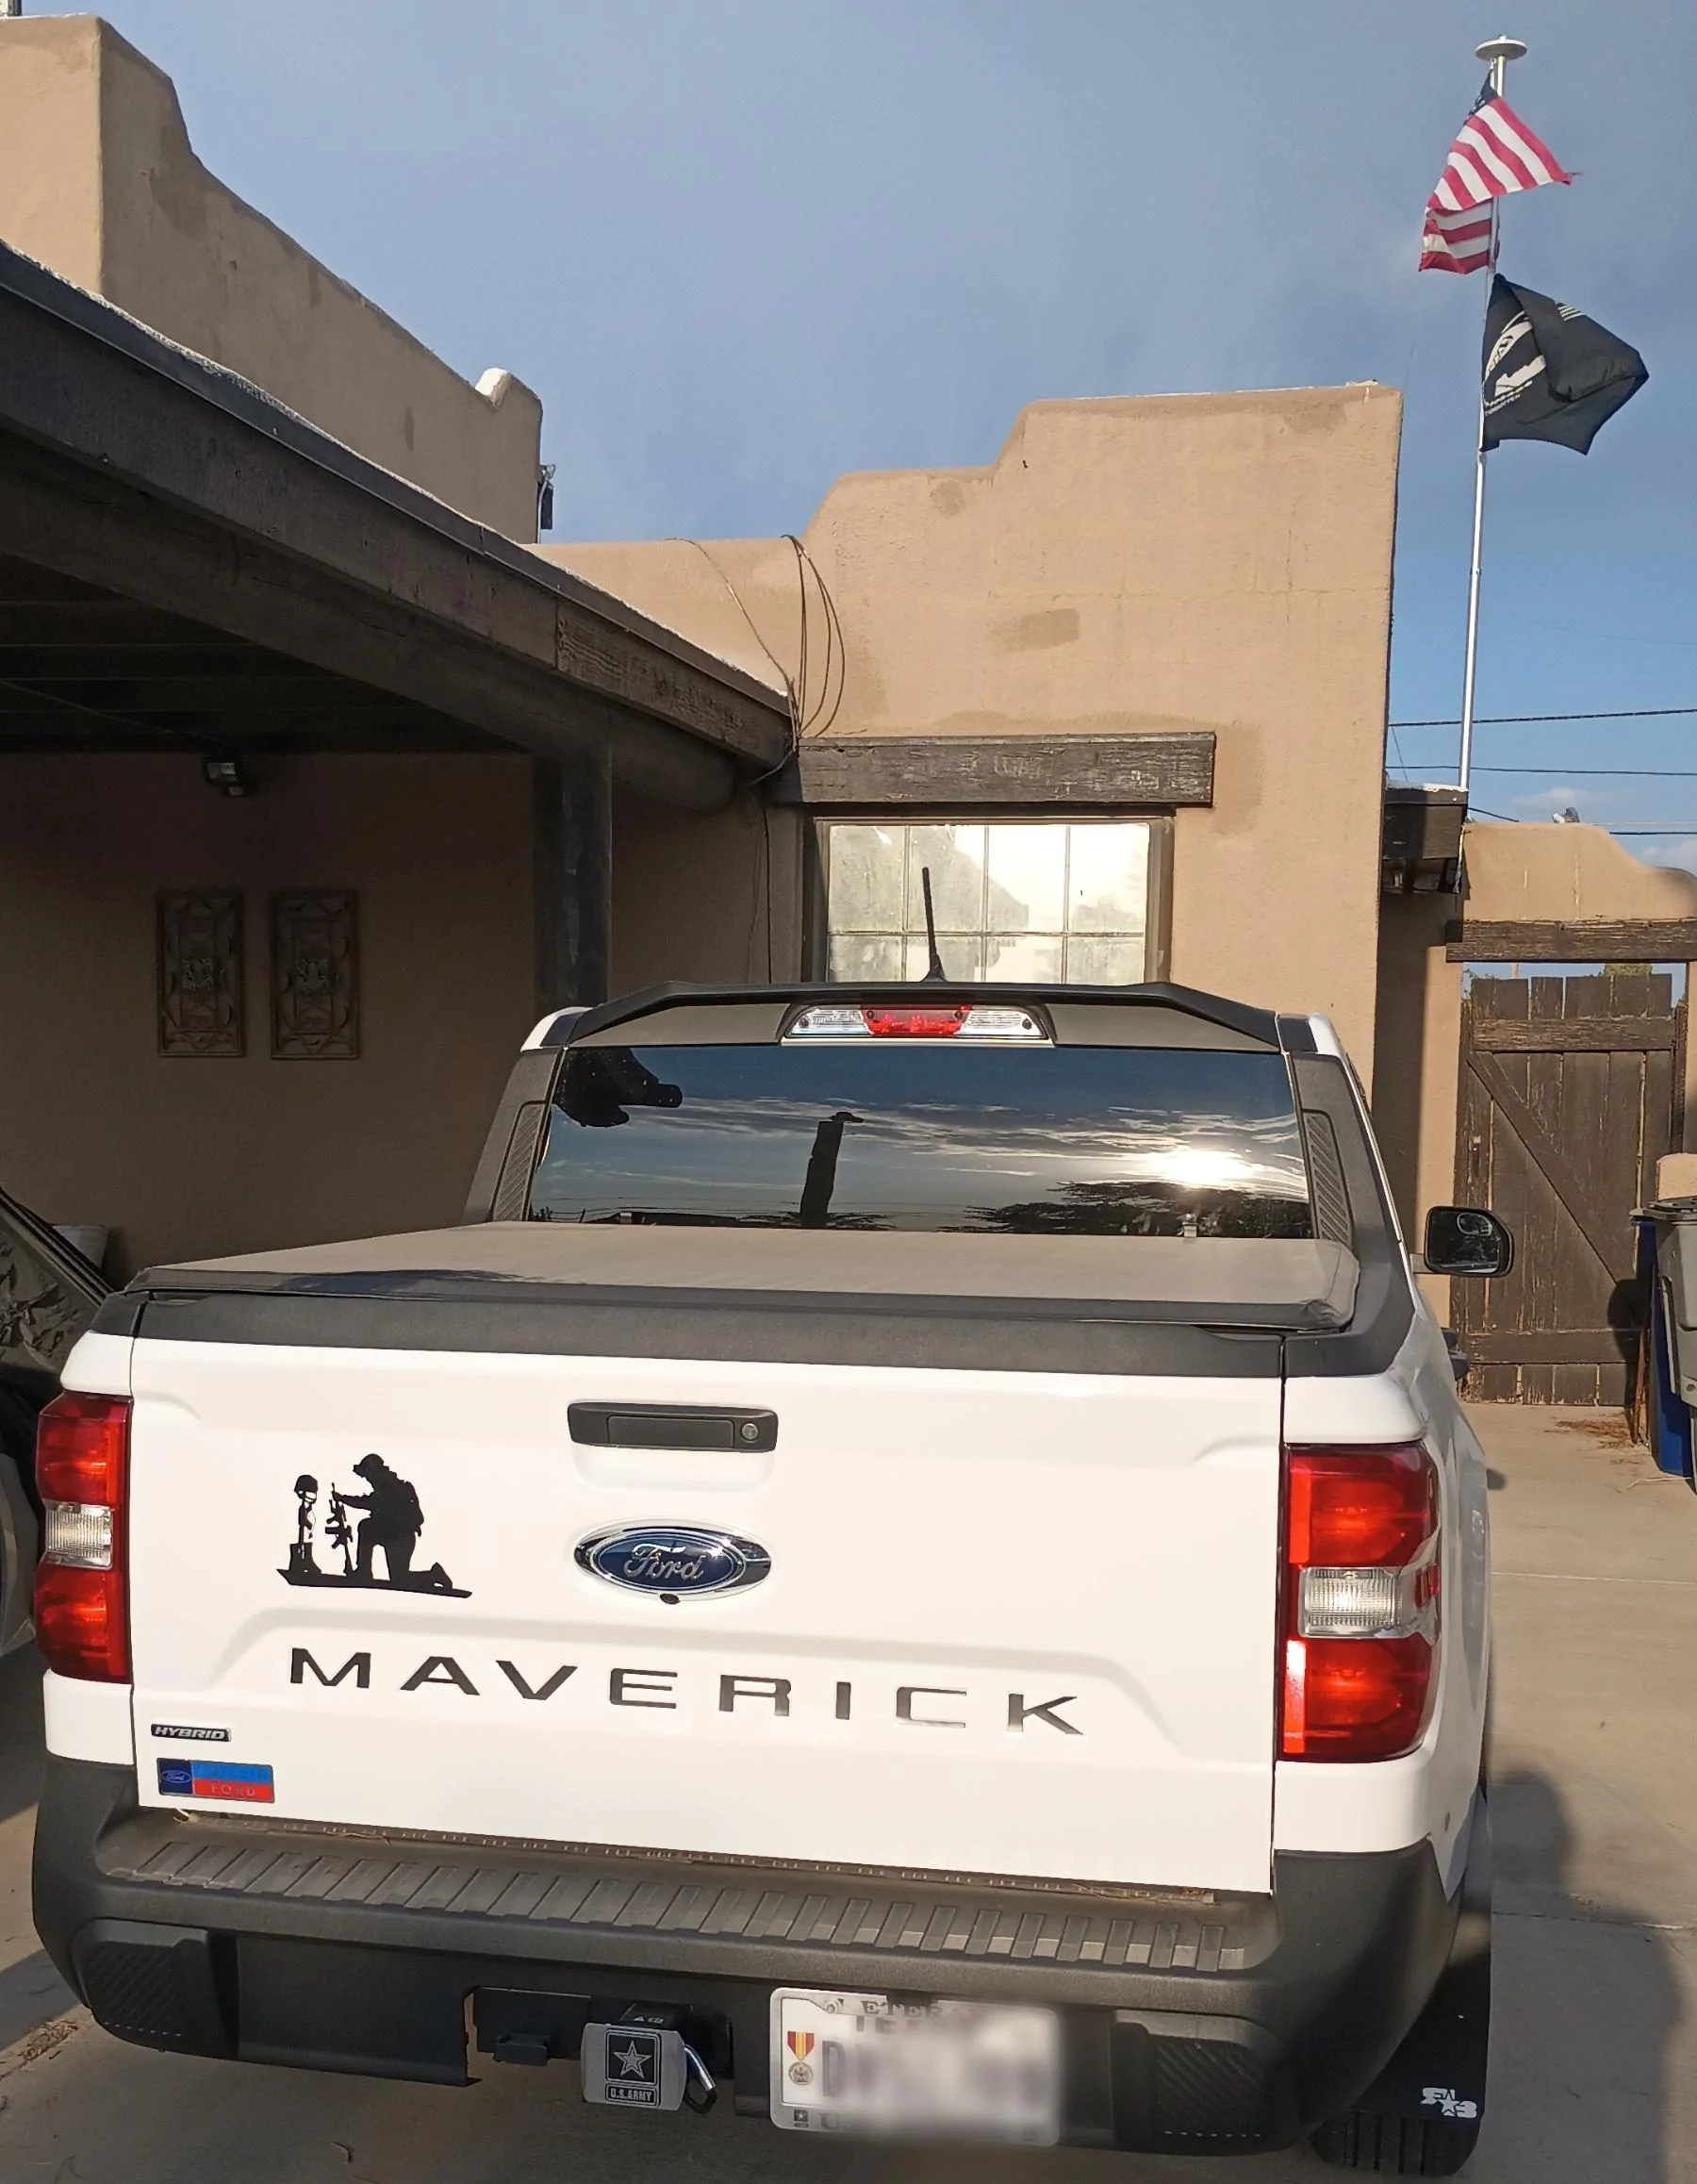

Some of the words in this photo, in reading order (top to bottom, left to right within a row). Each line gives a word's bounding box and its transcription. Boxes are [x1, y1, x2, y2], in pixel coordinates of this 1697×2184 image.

[623, 1544, 706, 1580] Ford
[290, 1647, 1084, 1735] MAVERICK
[155, 1727, 225, 1740] HYBRID
